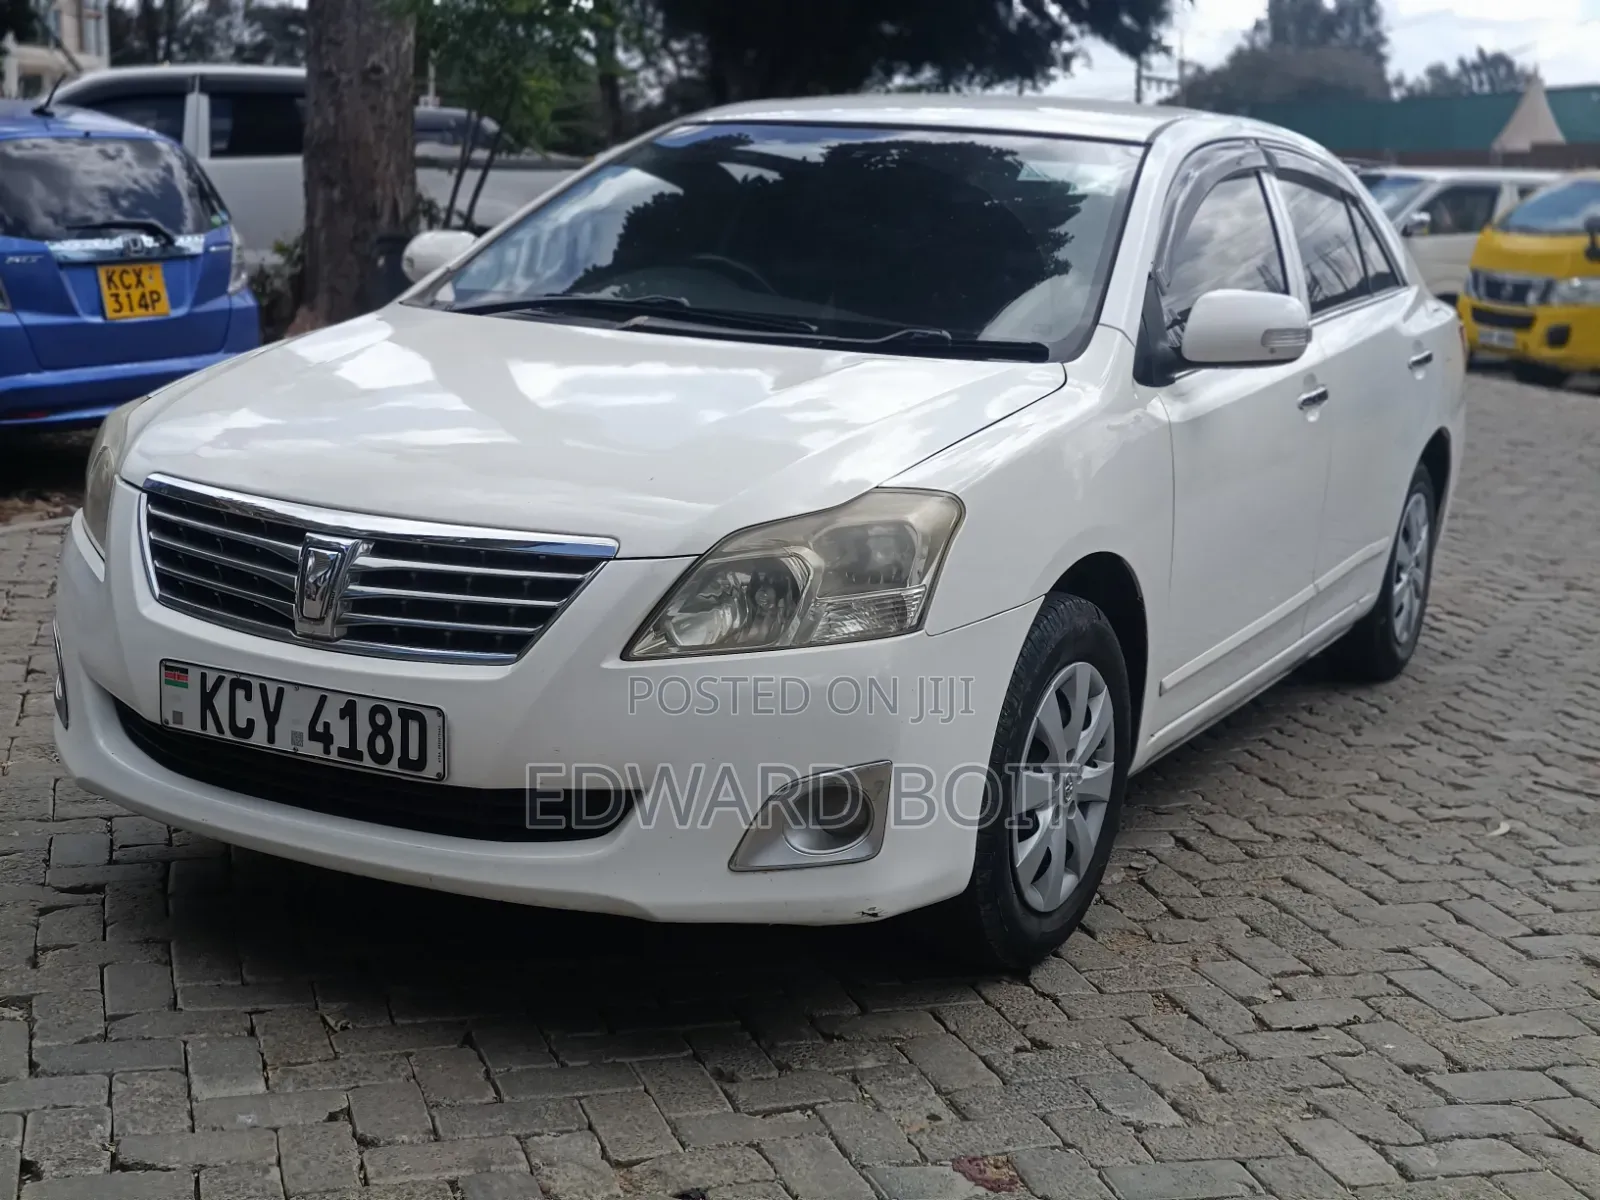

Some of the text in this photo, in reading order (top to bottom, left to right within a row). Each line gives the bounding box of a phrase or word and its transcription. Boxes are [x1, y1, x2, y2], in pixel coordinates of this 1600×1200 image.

[106, 268, 145, 291] KCX
[109, 290, 161, 313] 314P
[200, 671, 285, 744] KCY
[308, 694, 427, 772] 418D
